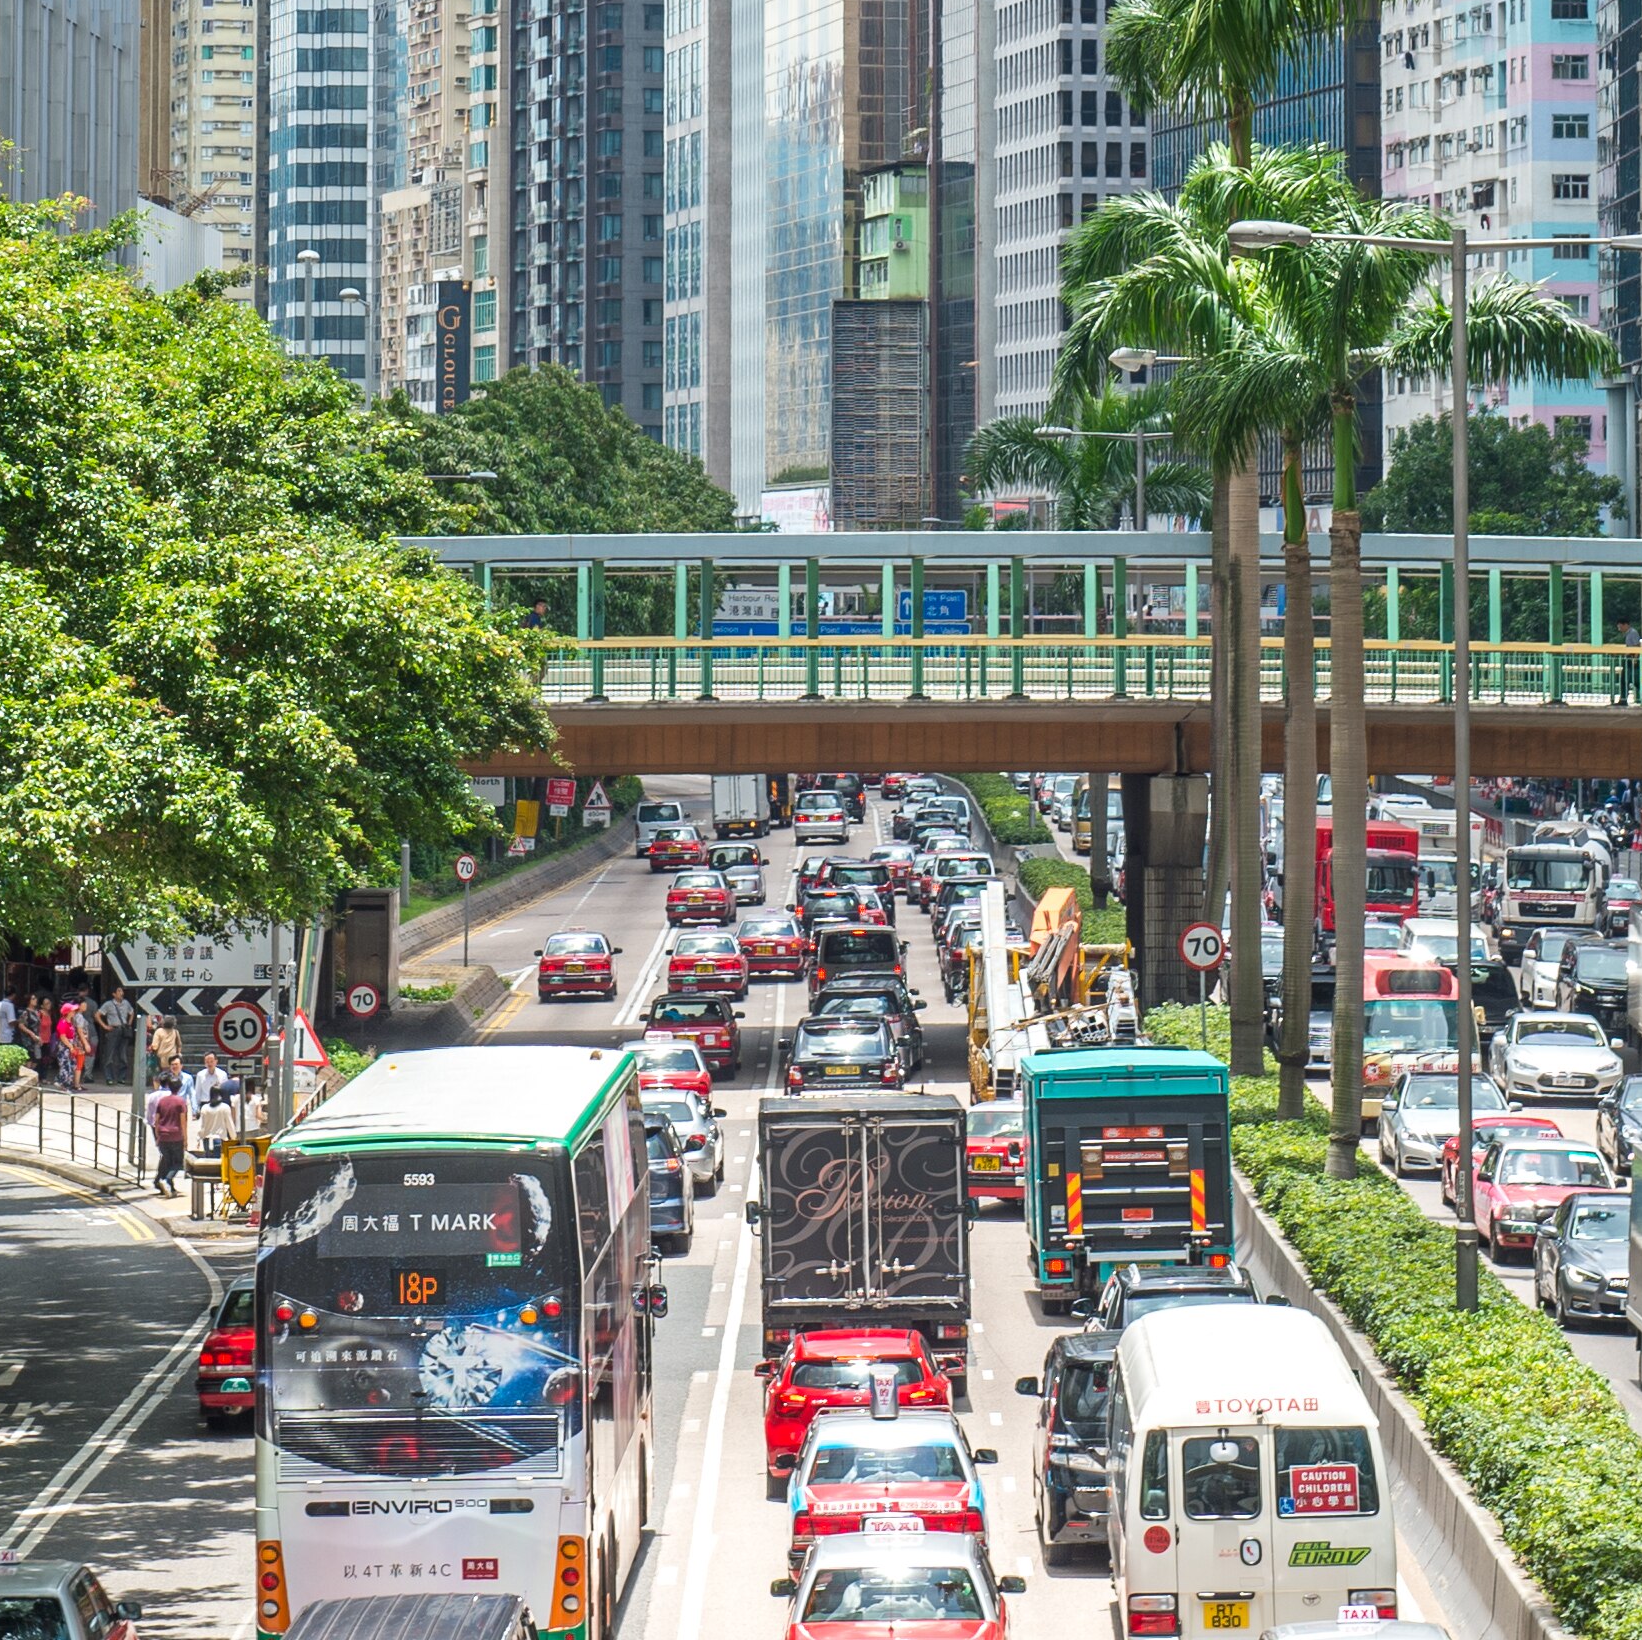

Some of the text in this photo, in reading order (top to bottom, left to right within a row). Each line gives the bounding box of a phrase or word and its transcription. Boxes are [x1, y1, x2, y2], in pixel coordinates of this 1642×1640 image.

[438, 305, 461, 330] G
[443, 333, 455, 416] GLOUCE
[728, 594, 761, 603] Harbour
[472, 777, 500, 786] North
[459, 861, 473, 875] 70
[144, 945, 214, 960] 香港會議
[1187, 935, 1220, 957] 70
[144, 967, 214, 982] 展覽中心
[352, 992, 374, 1008] 70
[222, 1017, 258, 1041] 50
[403, 1173, 435, 1186] 5593
[796, 1155, 934, 1220] Paion.
[341, 1213, 497, 1232] 周大福 T MARK
[399, 1272, 438, 1304] 18P
[875, 1378, 892, 1386] TAXI
[879, 1388, 890, 1406] 的士
[1301, 1471, 1347, 1482] CAUTION
[1298, 1482, 1352, 1494] CHILDREN
[351, 1498, 488, 1515] ENVIRO 500
[1296, 1495, 1355, 1507] 小心學童
[870, 1521, 919, 1532] TAXI
[1215, 1603, 1236, 1616] RT
[1342, 1609, 1375, 1620] TAXI
[1211, 1615, 1241, 1628] 830
